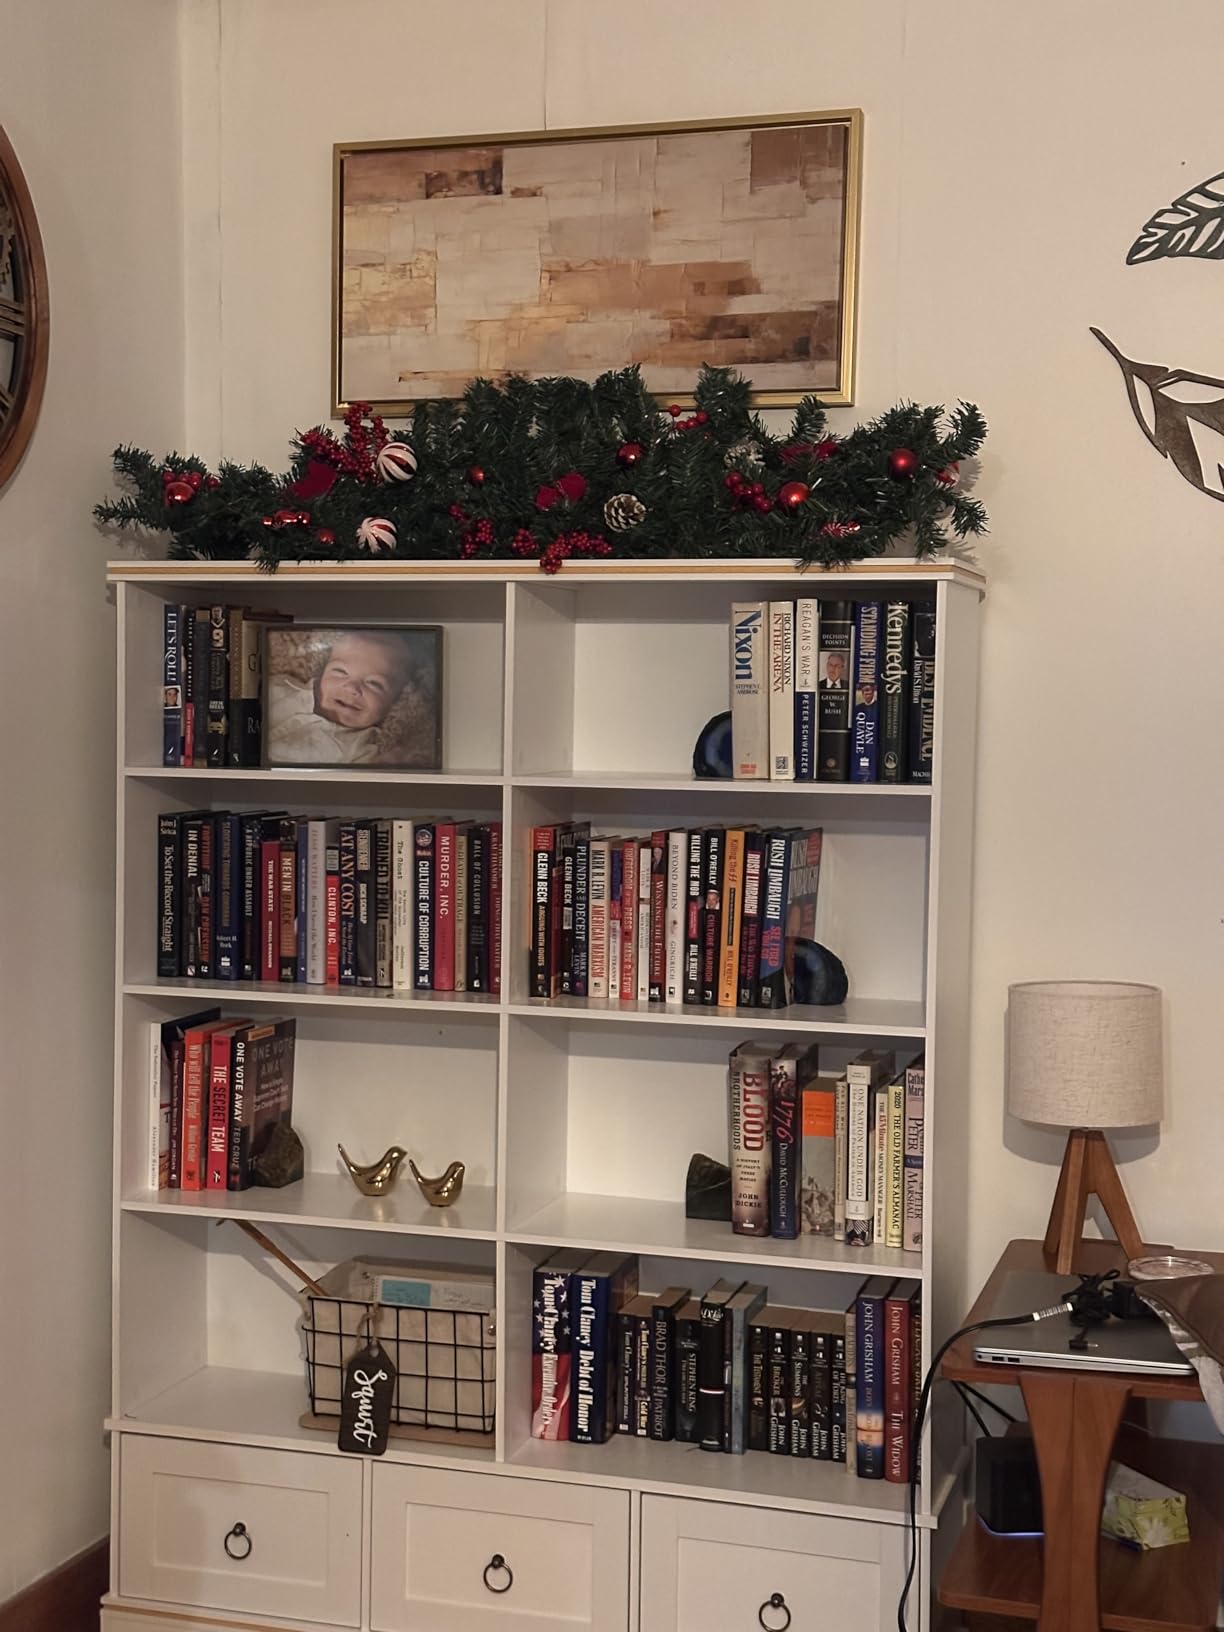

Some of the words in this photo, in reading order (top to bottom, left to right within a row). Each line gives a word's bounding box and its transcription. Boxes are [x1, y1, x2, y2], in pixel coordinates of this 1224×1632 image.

[166, 612, 177, 646] LET'S
[773, 612, 782, 628] IN
[784, 612, 792, 654] RICHARD
[802, 603, 812, 651] REAGAN'S
[860, 606, 877, 656] STANDING
[735, 610, 762, 680] Nixon
[773, 629, 782, 651] THE
[881, 603, 908, 694] Kennedys
[165, 647, 177, 681] ROLL!
[773, 651, 782, 692] ARENA
[784, 656, 792, 685] NIXON
[802, 656, 812, 675] WAR
[860, 658, 877, 683] FIRM
[801, 694, 810, 722] PETER
[856, 712, 866, 754] QUAYLE
[866, 722, 874, 744] DAN
[801, 724, 810, 774] SCHWEIZER
[188, 830, 198, 841] IN
[341, 832, 354, 850] AT
[692, 835, 700, 862] KILLING
[710, 837, 718, 853] BILL
[164, 846, 174, 856] To
[164, 856, 174, 870] Set
[188, 843, 198, 878] DENIAL
[341, 851, 354, 880] ANY
[377, 829, 389, 878] TRAINED
[439, 836, 449, 892] MURDER,
[592, 849, 605, 870] MARK
[746, 853, 760, 874] RUSH
[770, 839, 785, 866] RUSH
[164, 870, 174, 885] the
[282, 857, 292, 878] MEN
[419, 861, 429, 900] CULTURE
[536, 853, 548, 880] GLENN
[564, 856, 573, 881] GLENN
[576, 846, 586, 894] PLUNDER
[691, 865, 700, 878] THE
[708, 854, 718, 885] O'REILLY
[282, 880, 292, 891] IN
[377, 881, 389, 897] TO
[536, 882, 548, 903] BECK
[564, 883, 573, 904] BECK
[592, 880, 605, 900] LEVIN
[690, 881, 699, 896] MOB
[744, 876, 758, 914] LIMBAUGH
[766, 868, 783, 919] LIMBAUGH
[164, 885, 174, 916] Record
[282, 895, 292, 925] BLACK
[327, 887, 336, 925] CLINTON,
[341, 883, 354, 918] COST
[419, 902, 429, 913] OF
[439, 895, 449, 919] INC.
[654, 881, 663, 921] WINNING
[161, 917, 173, 952] Straight
[327, 928, 336, 945] INC.
[576, 903, 586, 941] DECEIT
[592, 905, 605, 941] AMERICAN
[654, 925, 663, 939] THE
[706, 914, 714, 946] CULTURE
[419, 915, 429, 970] CORRUPTION
[623, 942, 632, 962] MARK
[689, 944, 698, 956] BILL
[592, 943, 605, 978] MARXISM
[654, 942, 663, 976] FUTURE
[689, 958, 698, 980] O'REILLY
[704, 949, 713, 982] WARRIOR
[623, 973, 632, 993] LEVIN
[236, 1042, 245, 1063] ONE
[213, 1066, 227, 1083] THE
[235, 1065, 245, 1090] VOTE
[212, 1086, 226, 1122] SECRET
[233, 1093, 243, 1121] AWAY
[733, 1071, 741, 1150] BROTHERHOODS
[743, 1072, 764, 1151] BLOOD
[894, 1091, 902, 1108] 2020
[232, 1127, 241, 1142] TED
[773, 1101, 795, 1143] 1776
[893, 1115, 901, 1130] THE
[908, 1117, 924, 1150] PETER
[211, 1126, 225, 1151] TEAM
[232, 1145, 241, 1168] CRUZ
[907, 1171, 917, 1220] MARSHALL
[543, 1278, 557, 1305] Tom
[581, 1279, 596, 1303] Tom
[540, 1308, 558, 1353] Clancy
[576, 1306, 595, 1346] Clancy
[863, 1302, 873, 1330] JOHN
[892, 1306, 903, 1333] JOHN
[656, 1321, 666, 1350] BRAD
[579, 1350, 594, 1378] Debt
[656, 1353, 666, 1384] THOR
[688, 1352, 696, 1390] STEPHEN
[753, 1354, 763, 1364] THE
[864, 1333, 873, 1383] GRISHAM
[892, 1337, 903, 1384] GRISHAM
[542, 1353, 557, 1393] Executive
[578, 1380, 593, 1392] of
[753, 1366, 763, 1394] TESTAMENT
[773, 1366, 781, 1395] BROKER
[794, 1361, 802, 1396] SUMMONS
[832, 1371, 839, 1381] OF
[351, 1368, 388, 1448] Squirt
[542, 1395, 557, 1424] Orders
[577, 1393, 593, 1432] Honor
[688, 1391, 696, 1412] KING
[655, 1398, 663, 1437] PATRIOT
[892, 1411, 903, 1430] THE
[770, 1417, 778, 1451] GRISHAM
[778, 1425, 786, 1445] JOHN
[791, 1419, 800, 1454] GRISHAM
[799, 1429, 807, 1448] JOHN
[812, 1422, 820, 1456] GRISHAM
[820, 1430, 828, 1450] JOHN
[832, 1424, 840, 1459] GRISHAM
[892, 1435, 903, 1476] WIDOW
